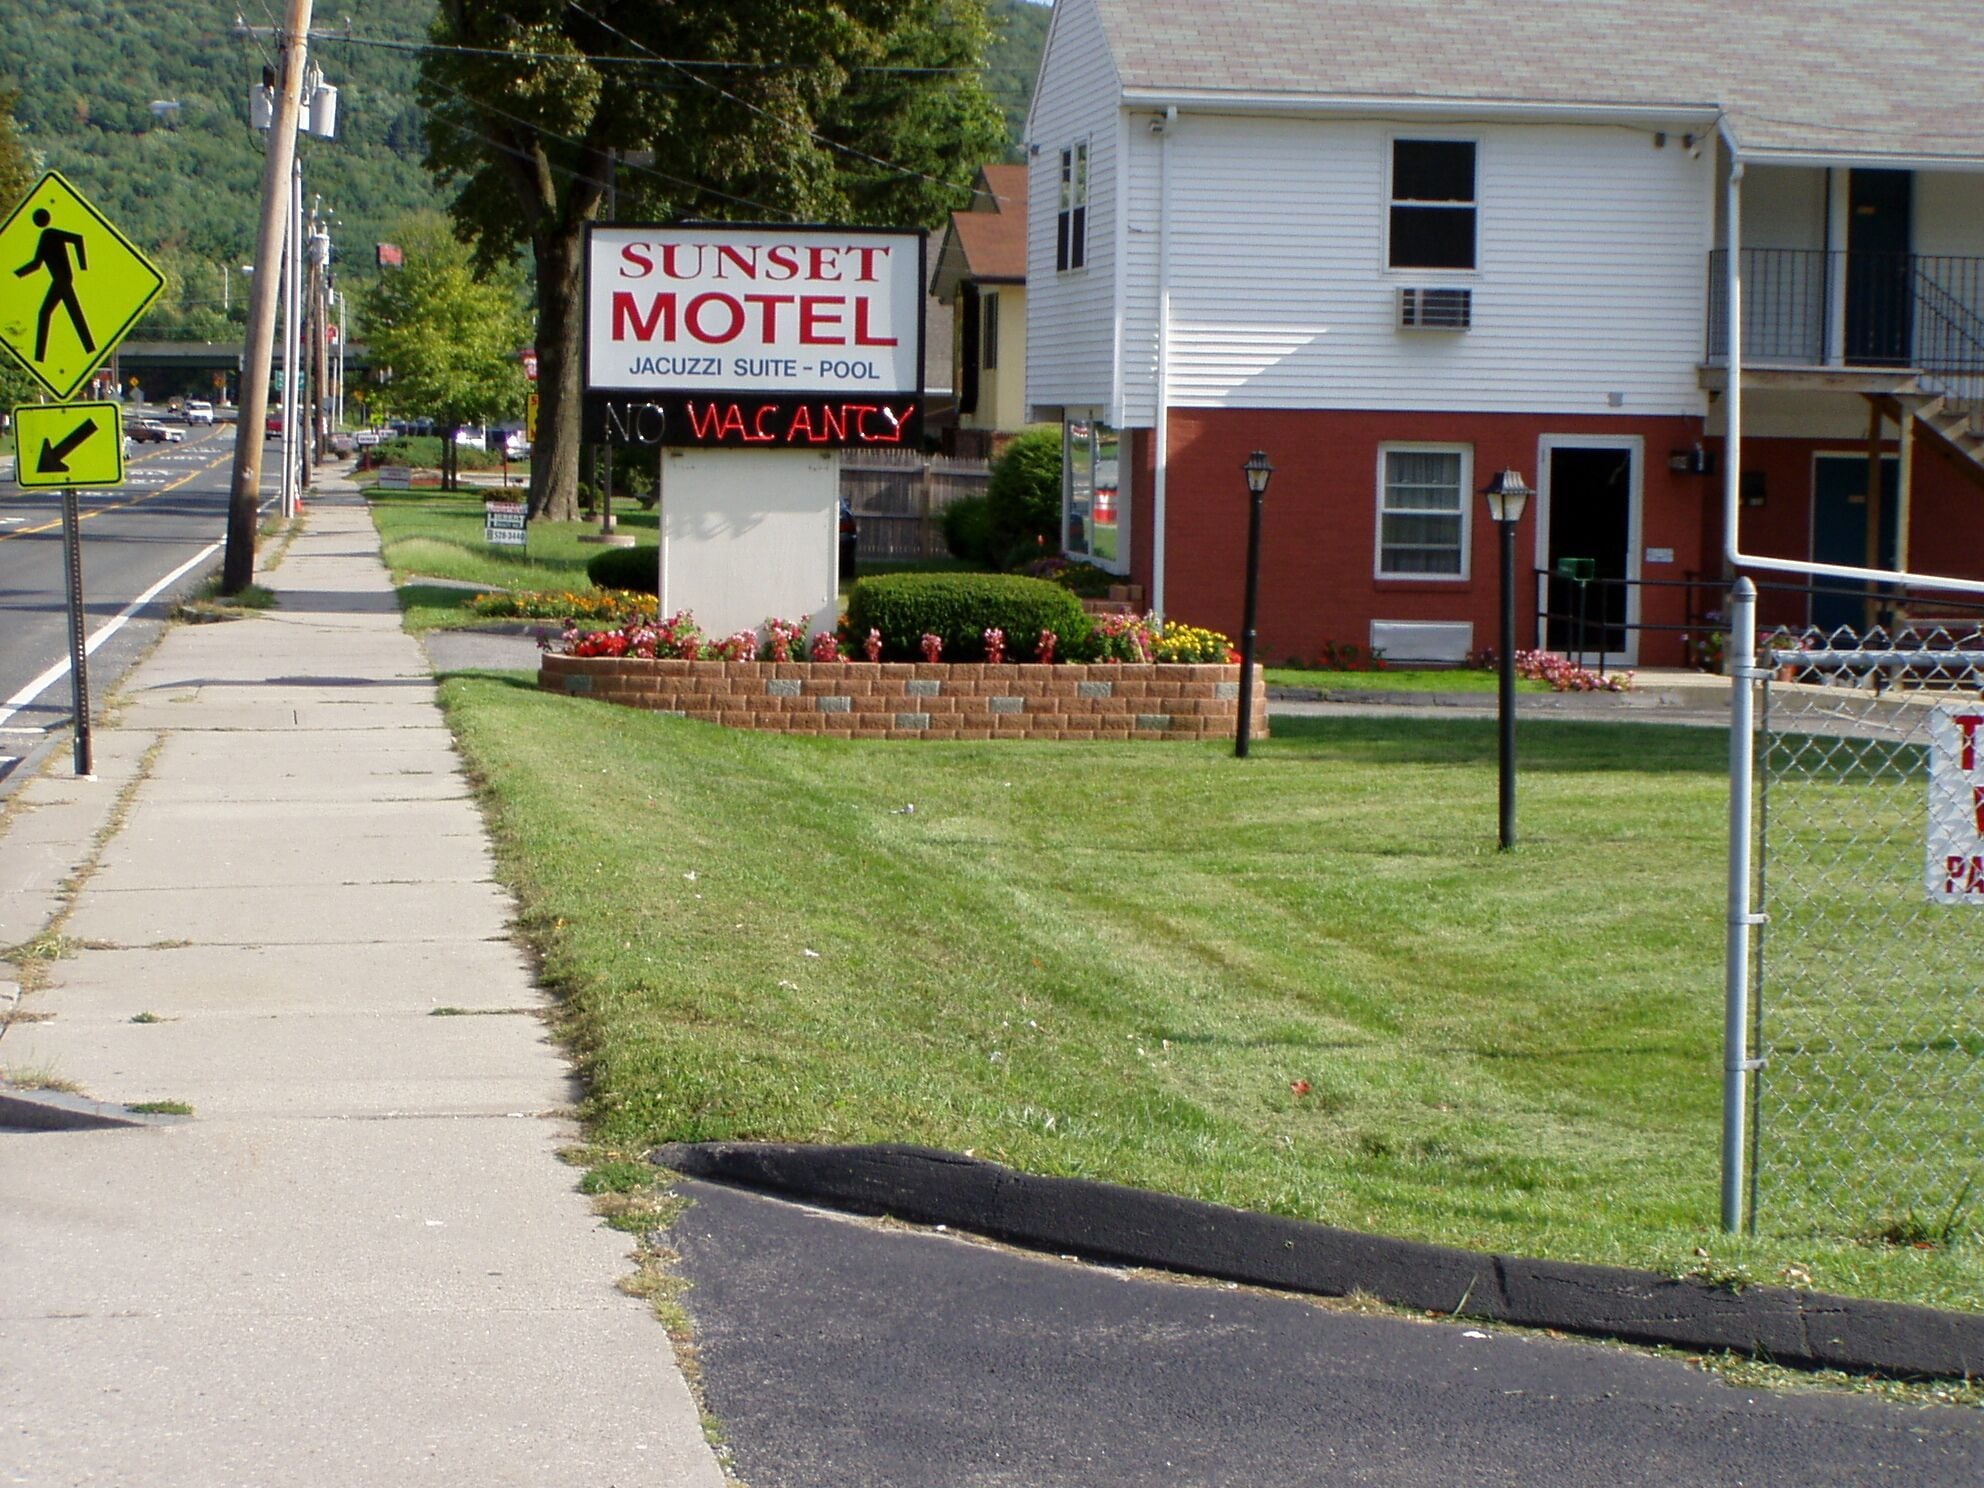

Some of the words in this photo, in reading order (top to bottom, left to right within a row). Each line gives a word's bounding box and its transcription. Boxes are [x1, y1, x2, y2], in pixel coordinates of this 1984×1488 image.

[619, 242, 891, 282] SUNSET
[611, 291, 898, 347] MOTEL
[629, 356, 722, 377] JACUZZI
[605, 402, 666, 444] NO
[687, 402, 915, 443] VACANCY
